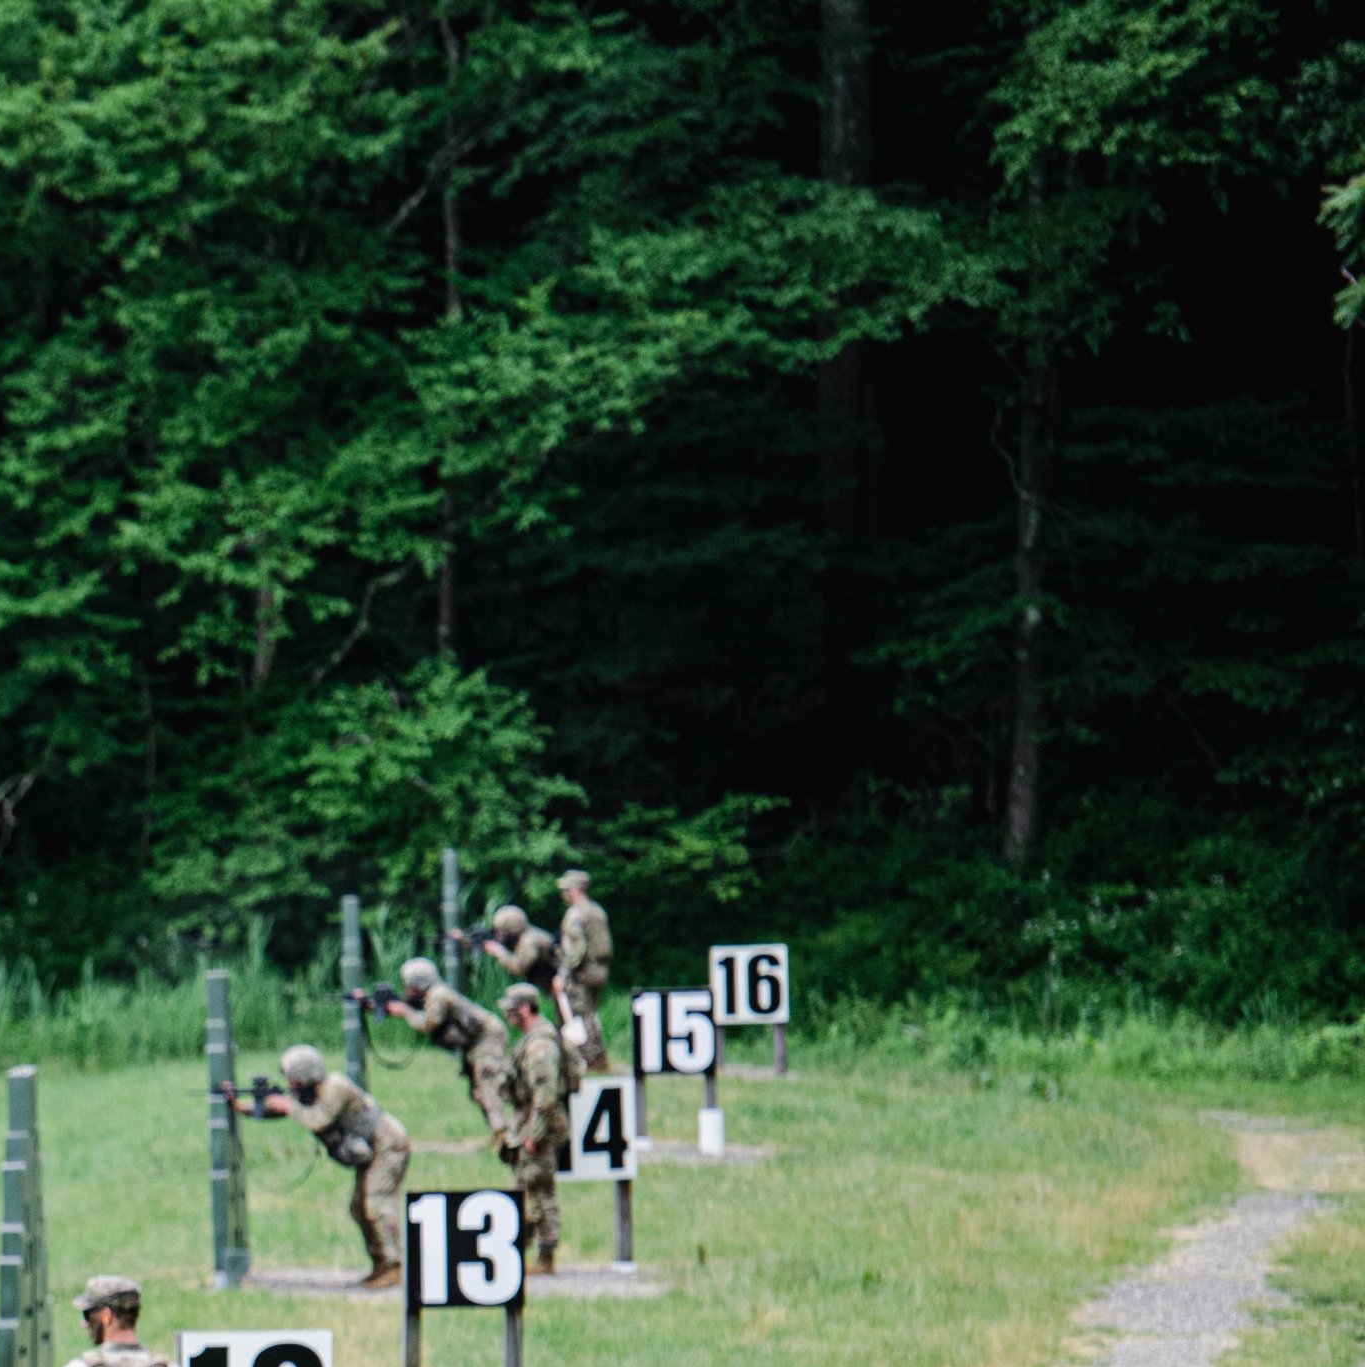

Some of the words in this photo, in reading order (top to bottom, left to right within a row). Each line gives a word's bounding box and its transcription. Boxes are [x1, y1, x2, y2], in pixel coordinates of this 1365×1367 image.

[719, 954, 780, 1014] 16
[632, 990, 716, 1074] 15
[556, 1088, 627, 1172] 4
[409, 1190, 522, 1306] 13
